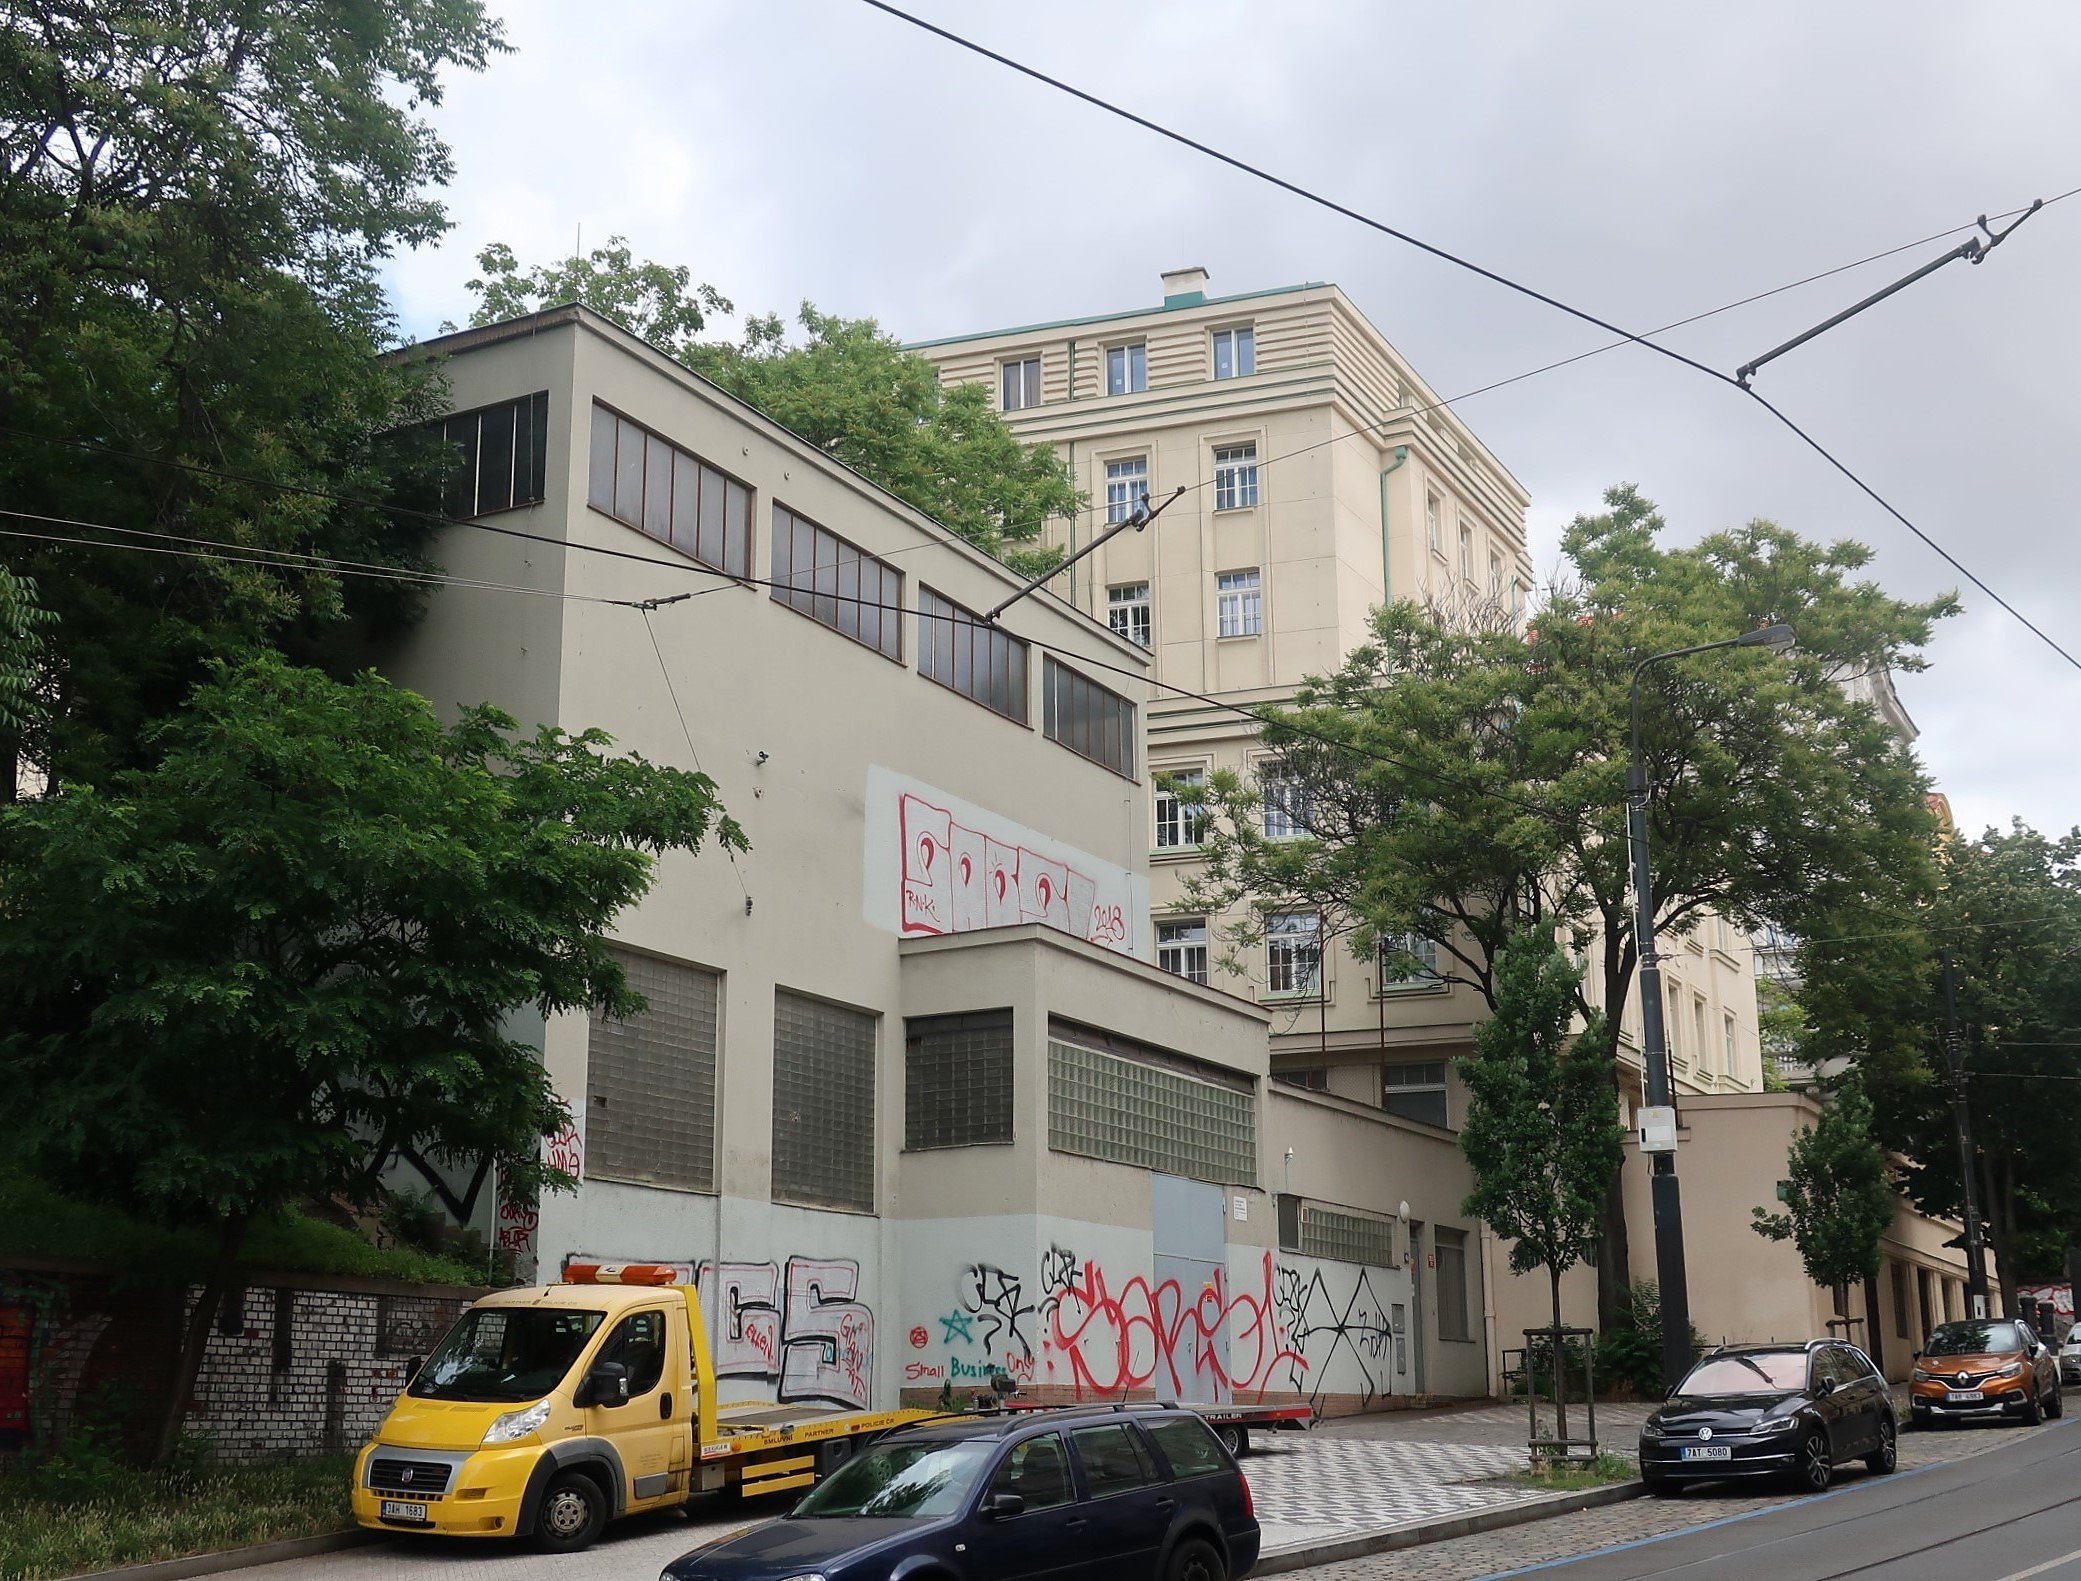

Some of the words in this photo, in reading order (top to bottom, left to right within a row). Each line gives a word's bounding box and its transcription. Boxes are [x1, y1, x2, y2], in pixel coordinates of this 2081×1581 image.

[1093, 904, 1125, 940] 2018
[804, 1428, 834, 1438] PARTNER
[861, 1419, 885, 1428] POLICIE
[1687, 1448, 1701, 1457] 7AT
[1707, 1447, 1728, 1457] 5080
[387, 1503, 400, 1514] 3AH
[405, 1504, 423, 1517] 1683
